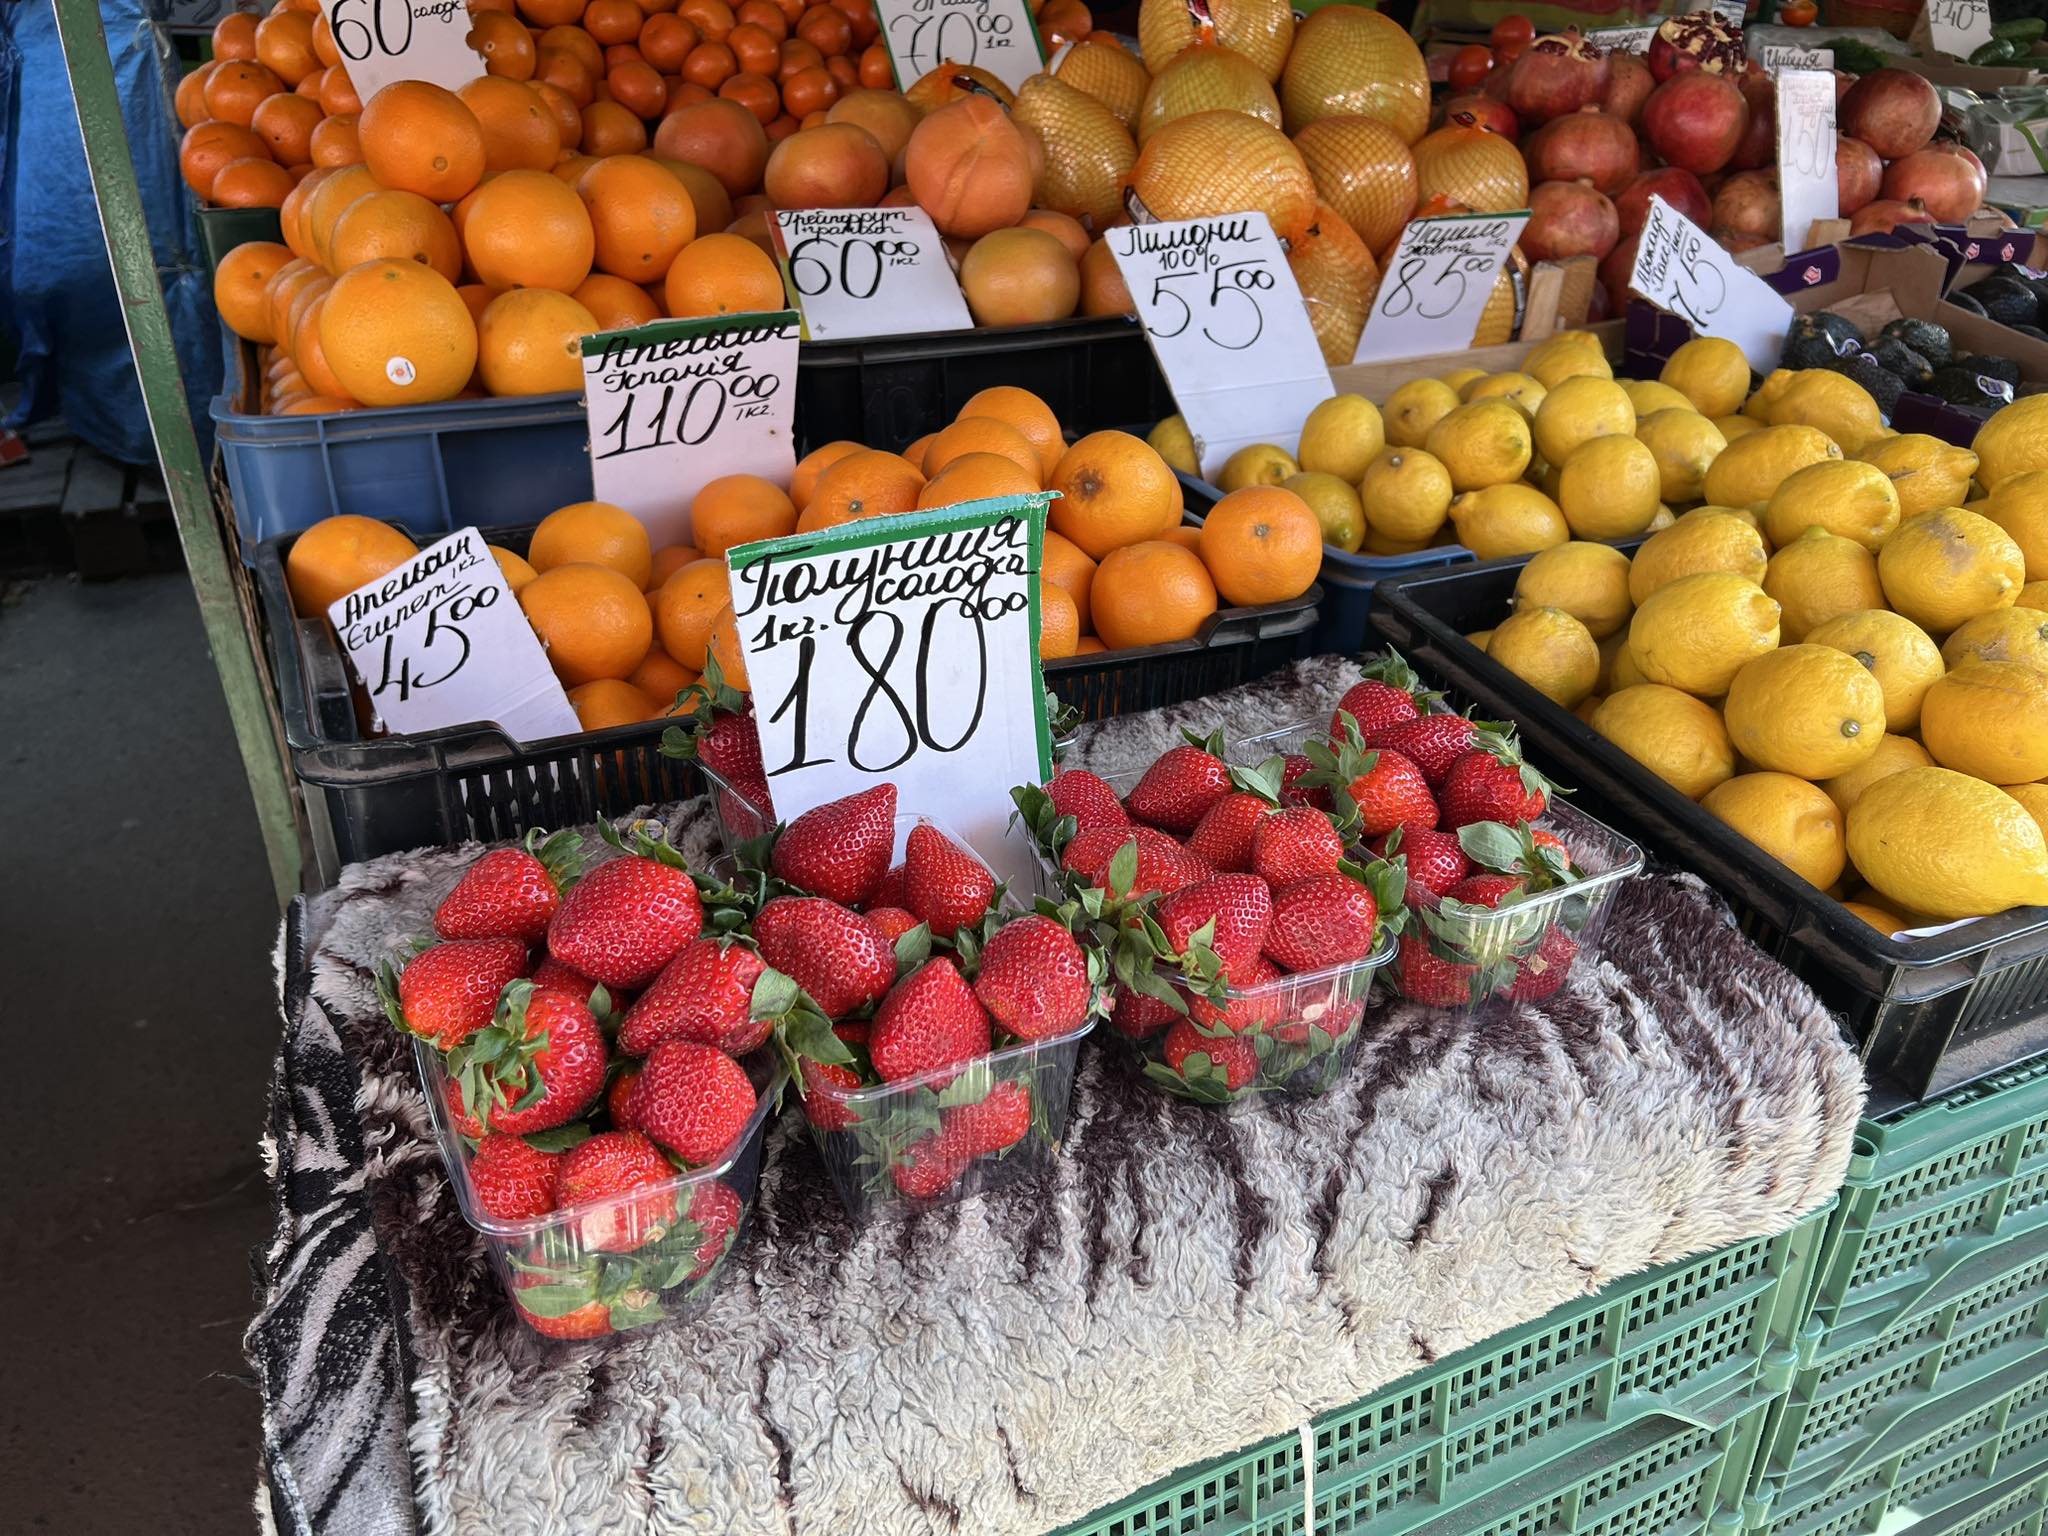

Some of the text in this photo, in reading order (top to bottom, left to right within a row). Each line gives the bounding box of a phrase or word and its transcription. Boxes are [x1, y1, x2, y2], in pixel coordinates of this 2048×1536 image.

[331, 0, 412, 61] 60
[788, 238, 883, 299] 60
[1119, 219, 1263, 257] Лимони
[1145, 259, 1269, 351] 55
[1382, 251, 1496, 320] 85
[586, 322, 800, 375] Апельсин
[595, 373, 781, 461] 110 00
[338, 535, 471, 632] Апельсин
[736, 514, 1033, 626] Полуниця
[372, 583, 500, 702] 45 00
[766, 597, 988, 778] 180
